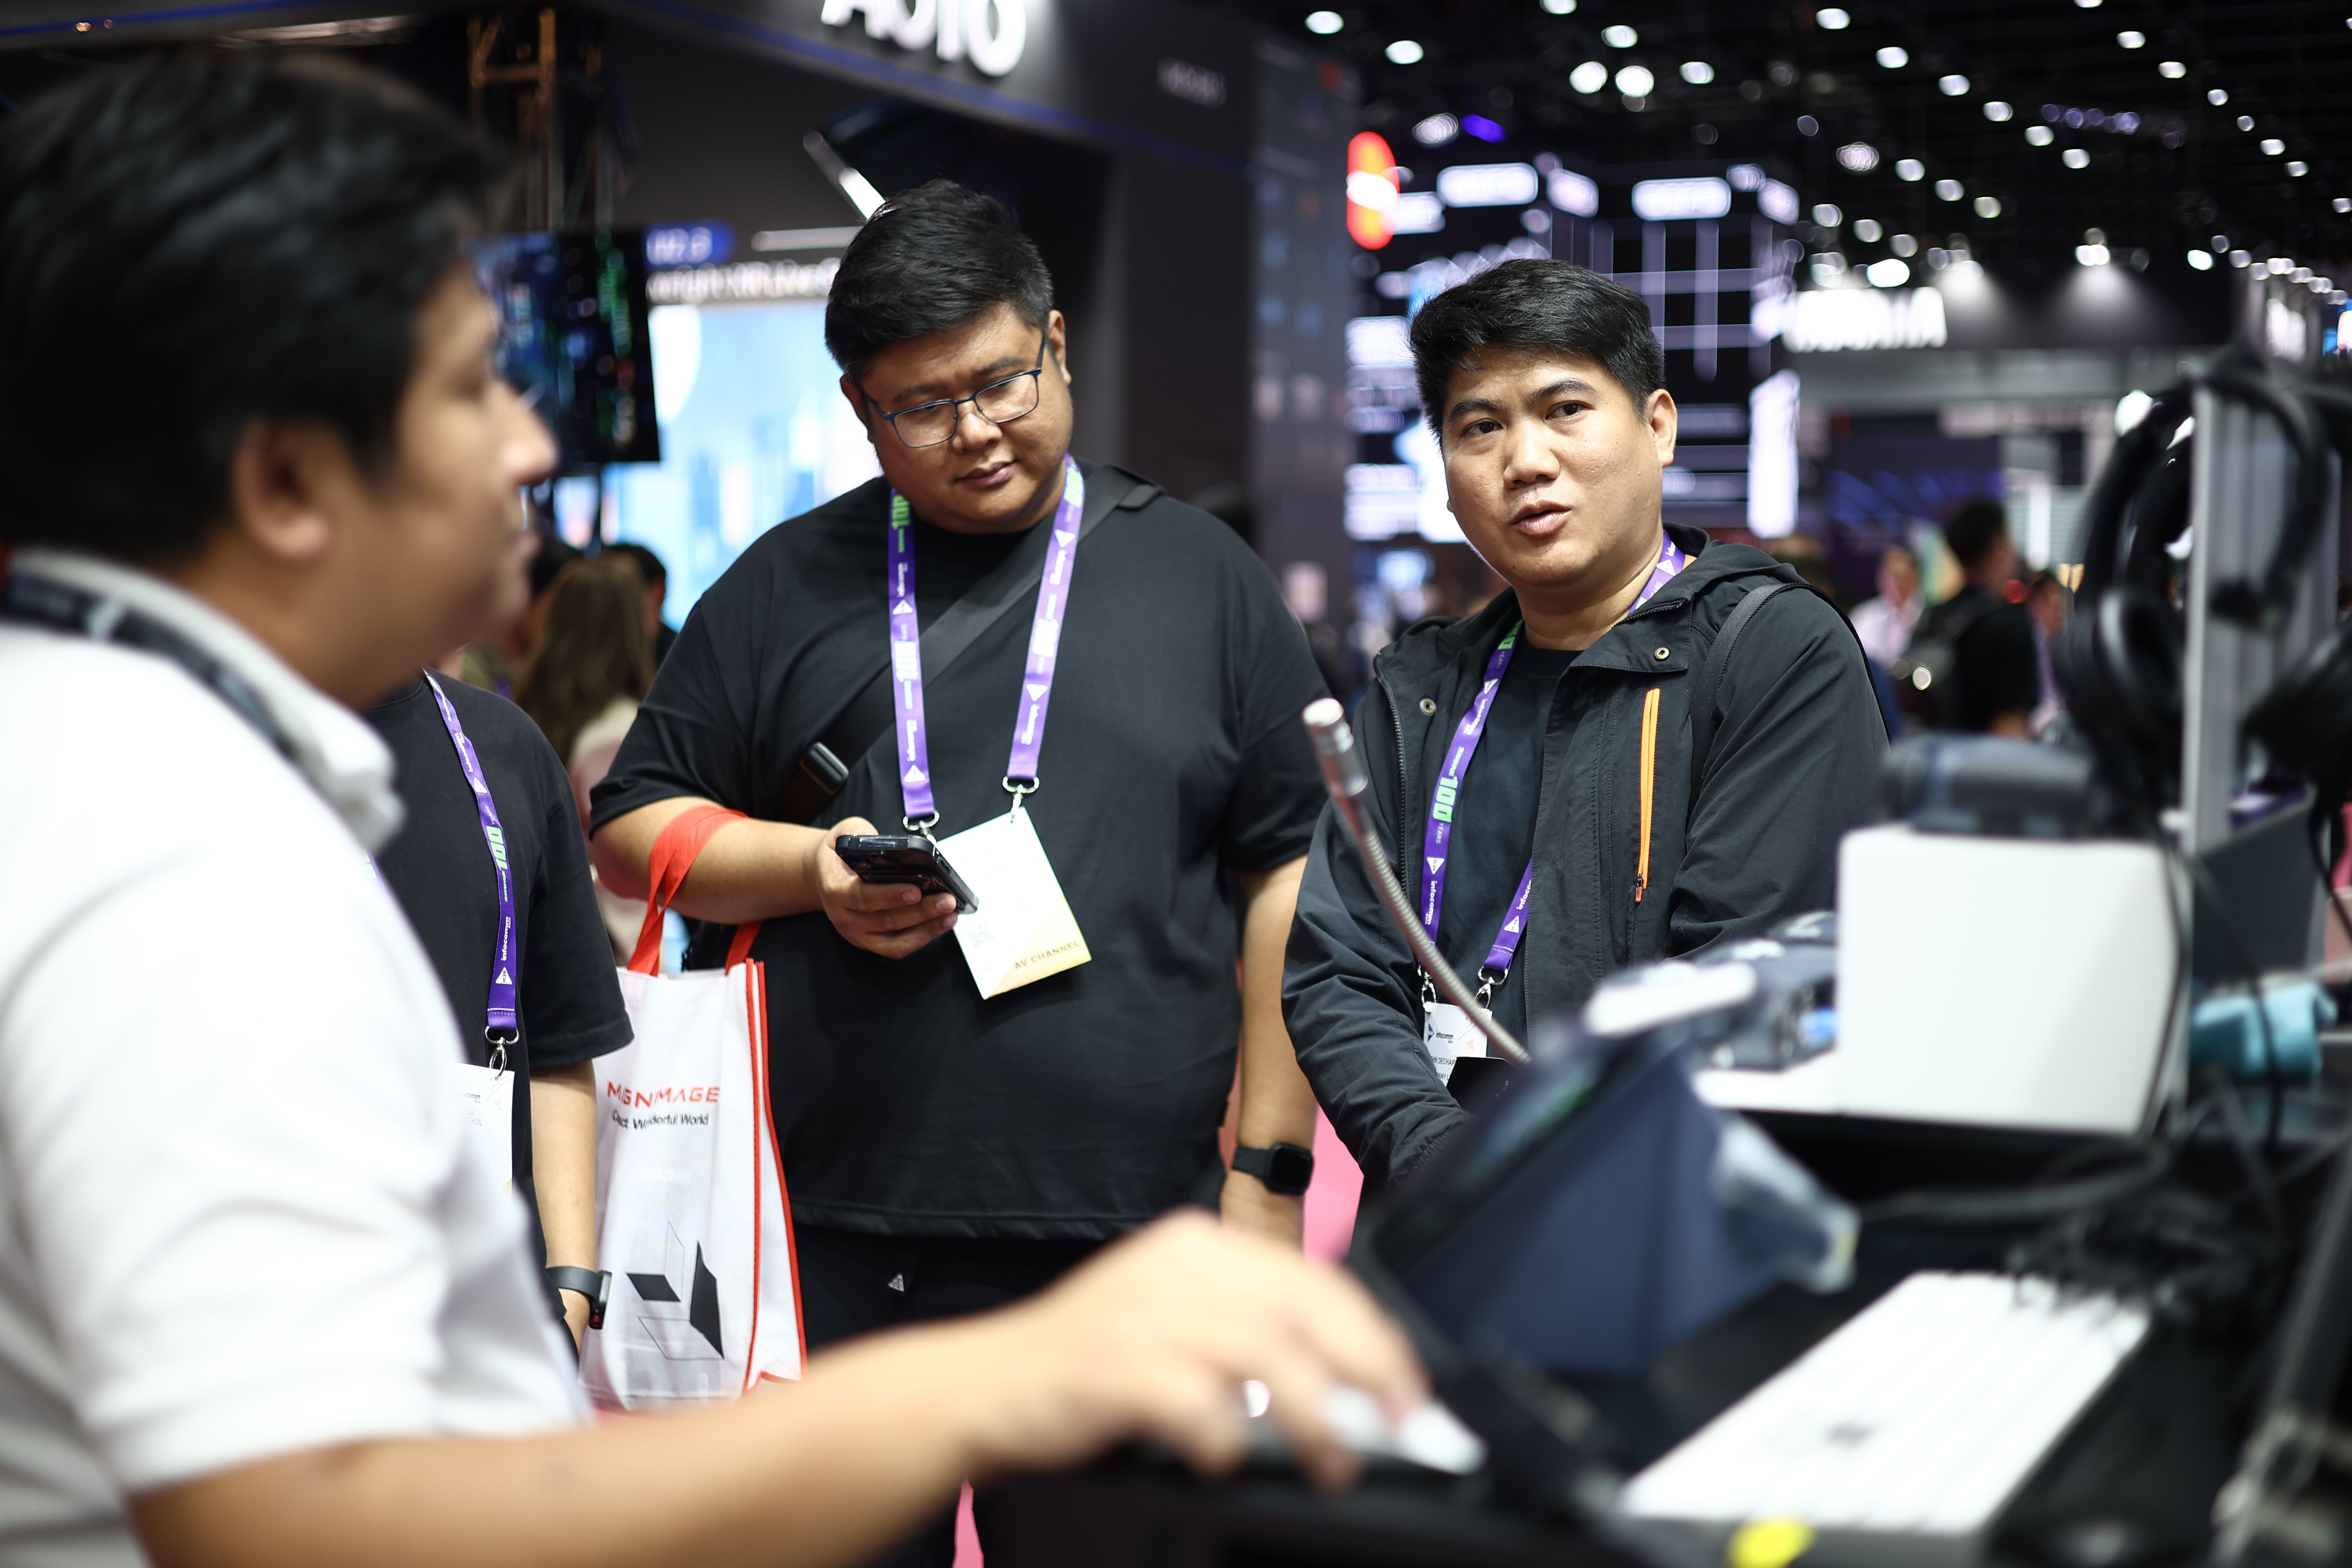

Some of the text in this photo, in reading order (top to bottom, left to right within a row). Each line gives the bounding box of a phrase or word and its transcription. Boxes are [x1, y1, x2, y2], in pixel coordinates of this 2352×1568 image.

[1432, 776, 1459, 823] 100
[486, 825, 508, 871] 100
[1436, 822, 1444, 844] YEARS
[1427, 880, 1438, 925] infocomm
[501, 916, 509, 961] infocomm
[1014, 941, 1080, 969] AV CHANNEL
[681, 1113, 709, 1126] World
